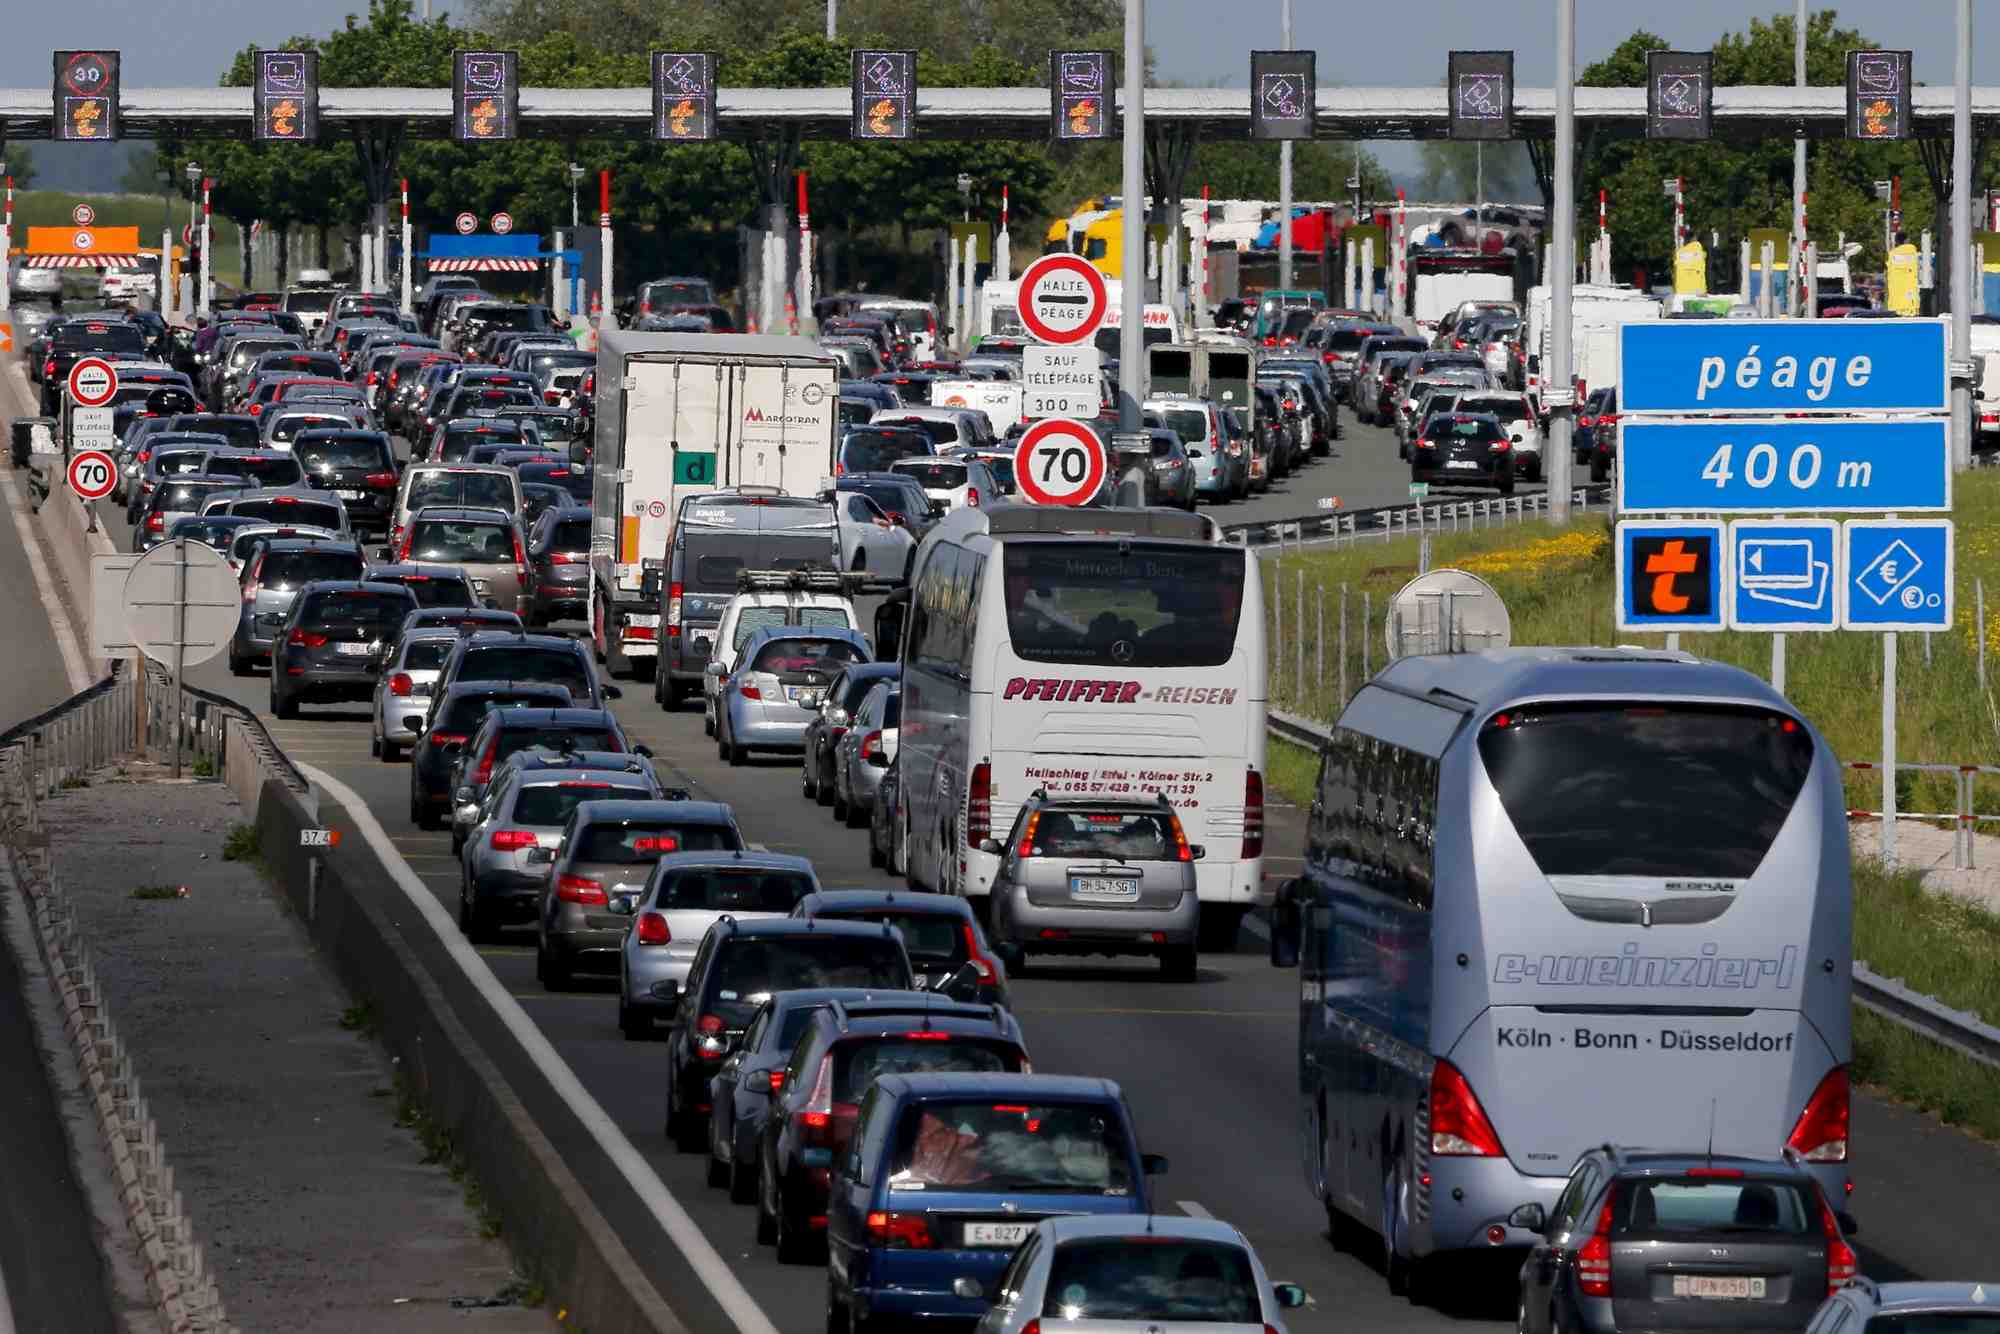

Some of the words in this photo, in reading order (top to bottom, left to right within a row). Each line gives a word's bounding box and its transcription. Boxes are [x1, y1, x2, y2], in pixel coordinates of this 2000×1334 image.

[1043, 281, 1084, 292] HALTE
[1040, 306, 1084, 320] PÉAGE
[1044, 355, 1078, 367] SAUF
[1027, 370, 1095, 385] TÉLÉPÉAGE
[1696, 345, 1872, 401] péage
[1035, 399, 1068, 412] 300
[1076, 403, 1088, 412] m
[80, 465, 107, 484] 70
[686, 456, 705, 482] d
[1038, 447, 1087, 483] 70
[1702, 443, 1822, 489] 400
[1837, 459, 1872, 488] m
[1138, 769, 1178, 781] Kölner
[1205, 773, 1213, 782] 2
[1493, 942, 1800, 990] e-weinzierl
[1497, 1027, 1552, 1048] Köln
[1574, 1028, 1638, 1050] Bonn
[1660, 1029, 1793, 1053] Düsseldorf
